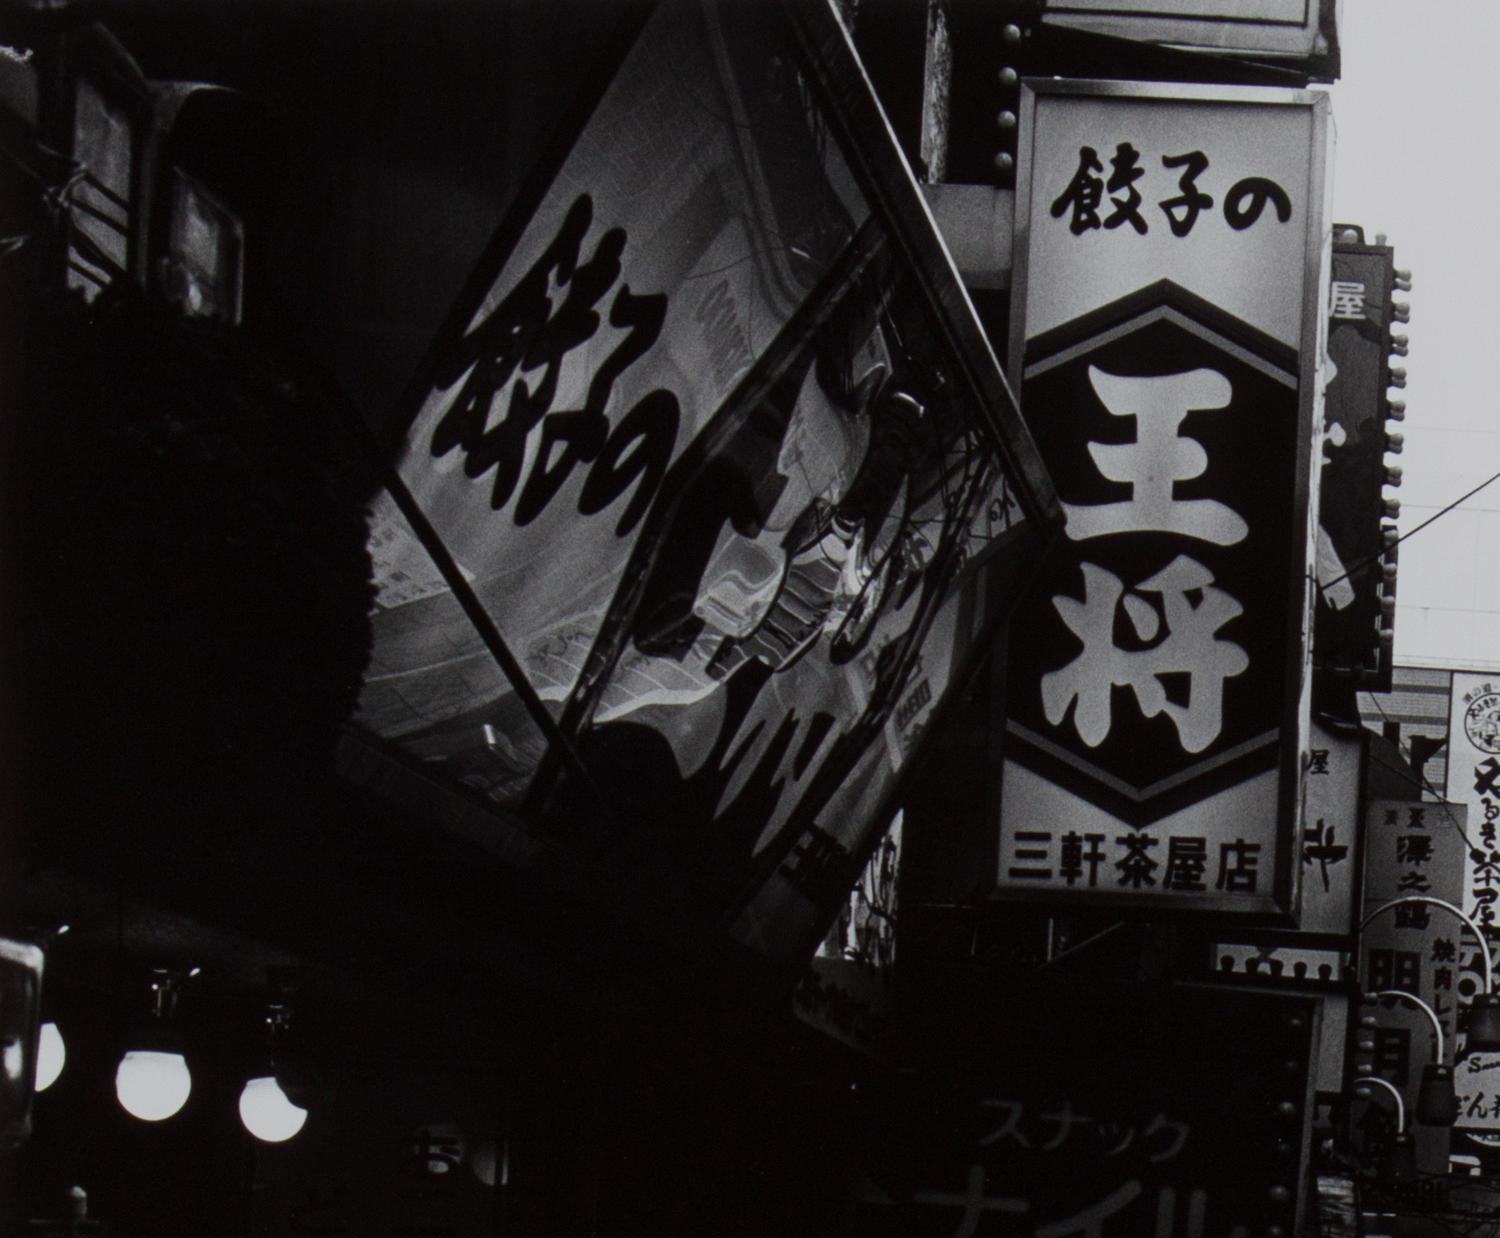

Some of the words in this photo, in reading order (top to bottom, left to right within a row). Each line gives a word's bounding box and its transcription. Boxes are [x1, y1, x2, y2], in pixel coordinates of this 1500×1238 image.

[1050, 143, 1292, 236] 餃子の
[1040, 363, 1250, 753] 王将
[1008, 830, 1263, 896] 三軒茶屋店
[977, 1096, 1192, 1165] スナック
